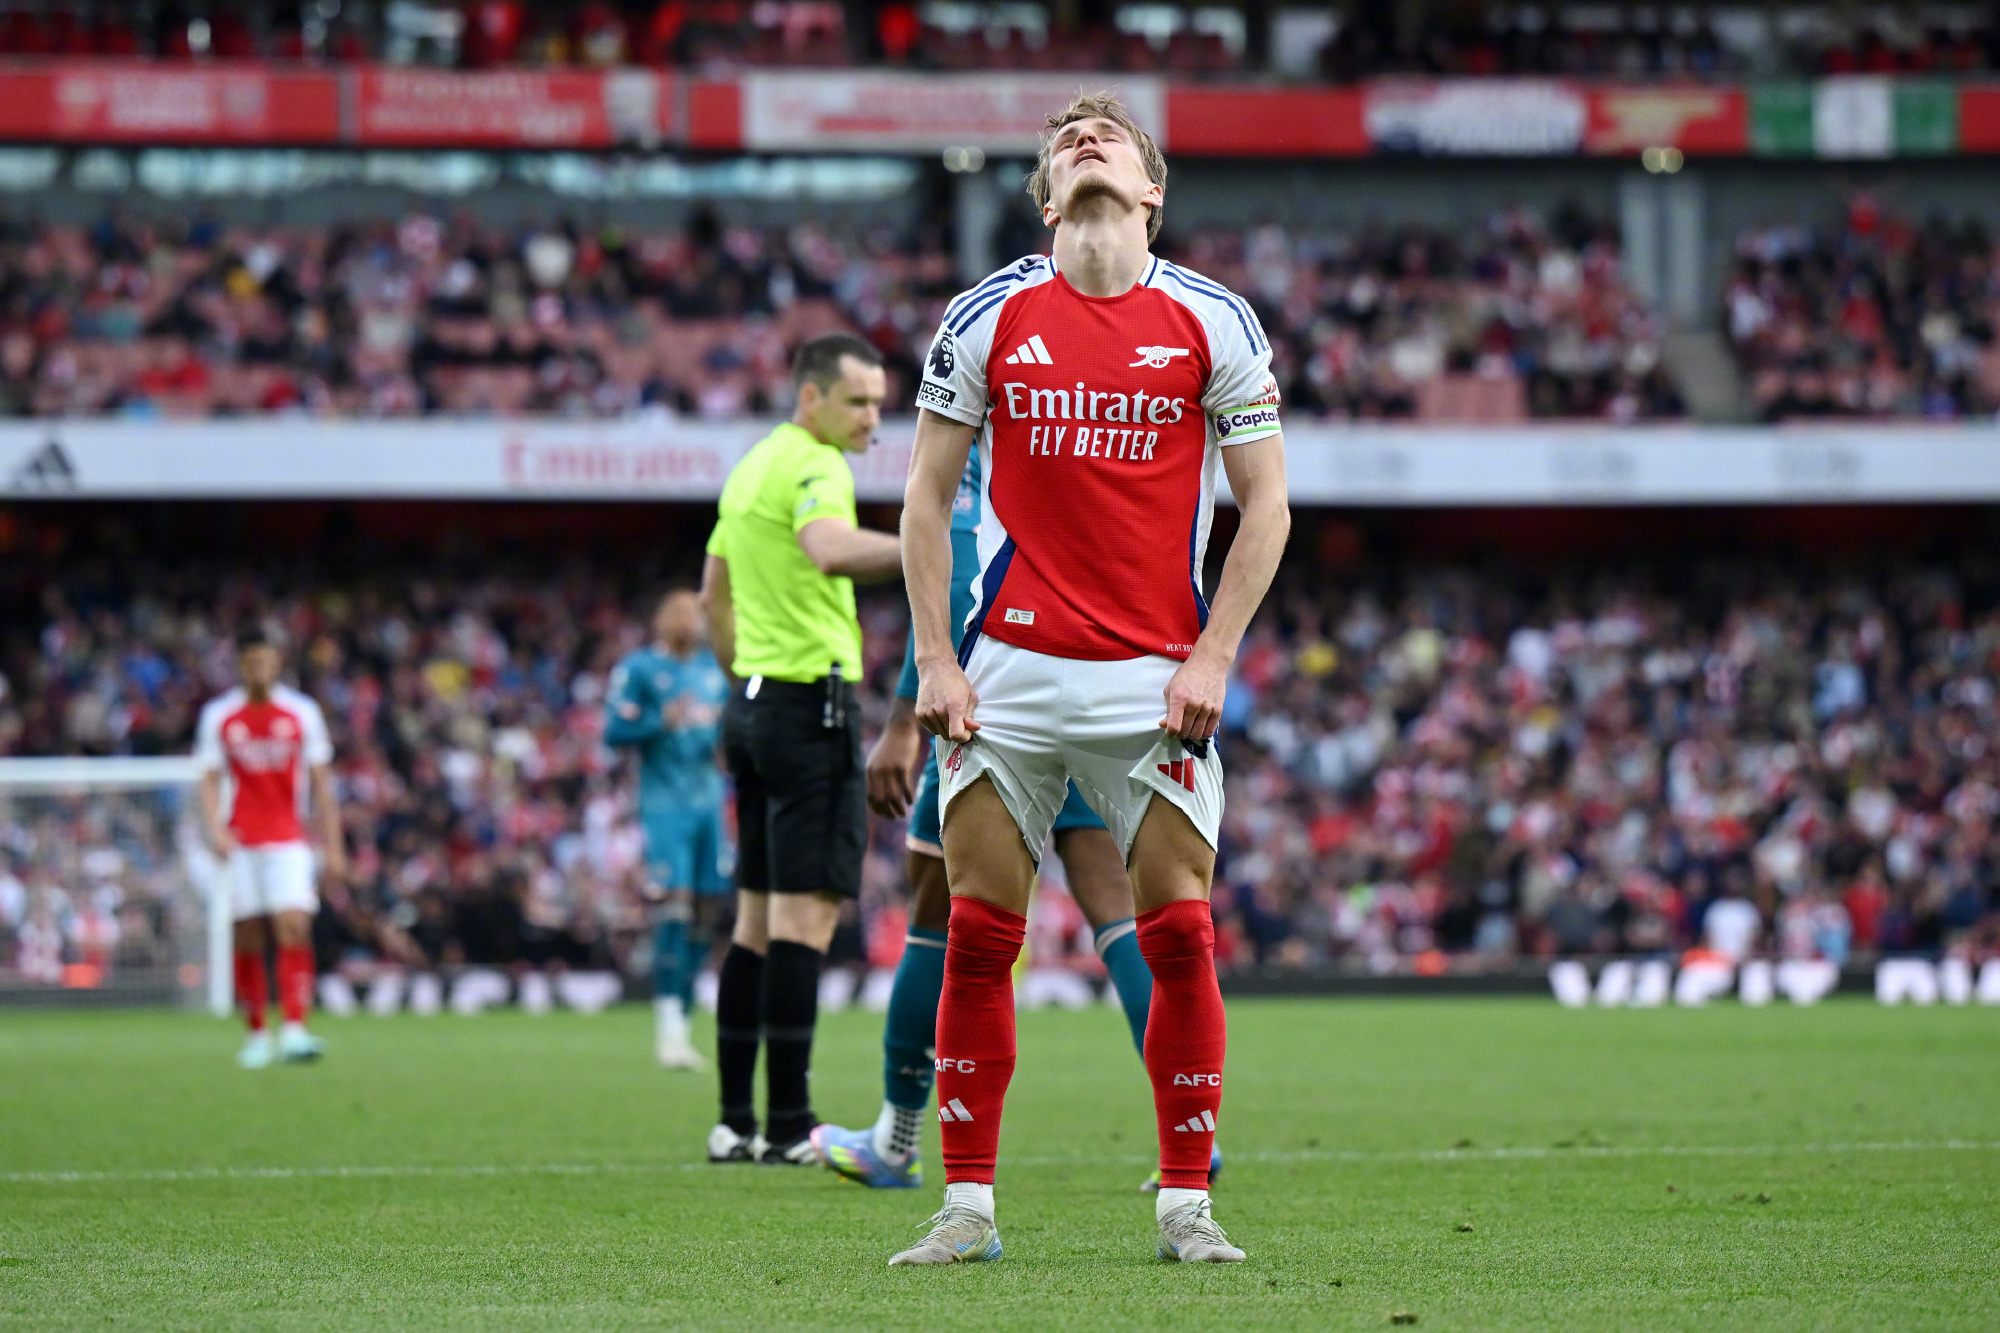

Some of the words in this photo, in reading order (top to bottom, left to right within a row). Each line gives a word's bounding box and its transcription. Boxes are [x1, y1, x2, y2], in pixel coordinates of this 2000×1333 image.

[923, 383, 951, 400] room
[1003, 381, 1185, 424] Emirates
[1030, 425, 1067, 456] FLY
[1073, 427, 1158, 461] BETTER
[935, 1058, 976, 1074] AFC
[1173, 1073, 1220, 1087] AFC
